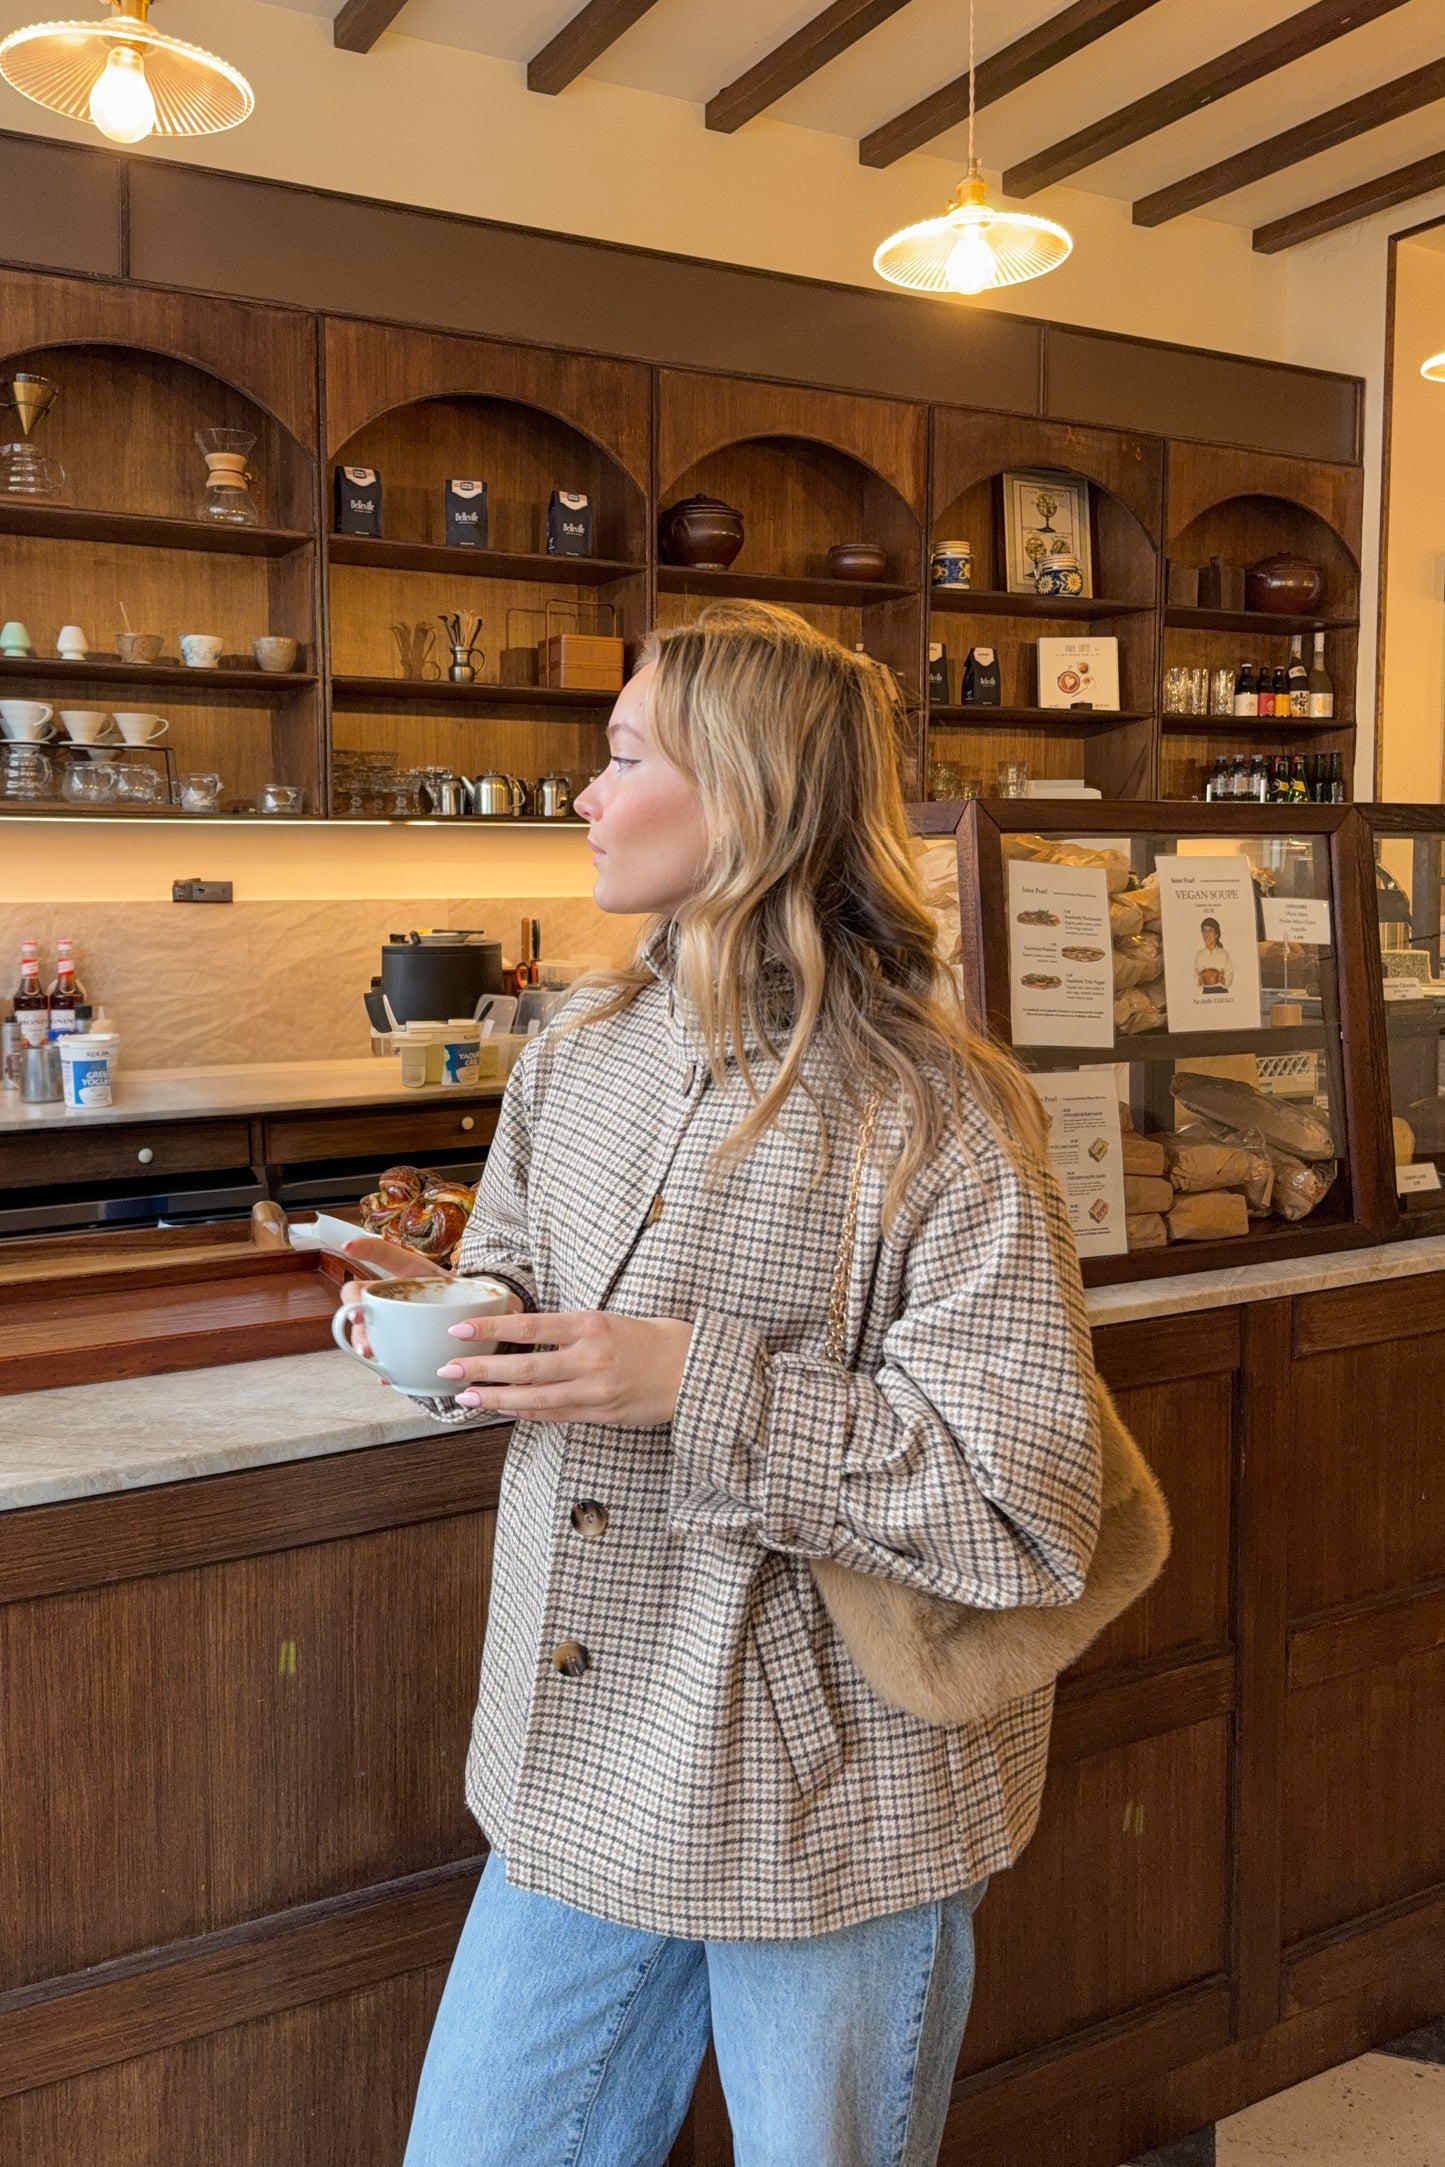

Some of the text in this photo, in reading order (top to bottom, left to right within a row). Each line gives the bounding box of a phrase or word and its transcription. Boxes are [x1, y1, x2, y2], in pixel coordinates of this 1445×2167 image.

[351, 499, 375, 511] Belleville
[455, 511, 479, 522] Belleville
[563, 522, 585, 534] Belleville
[1175, 889, 1239, 900] VEGAN SOUPE
